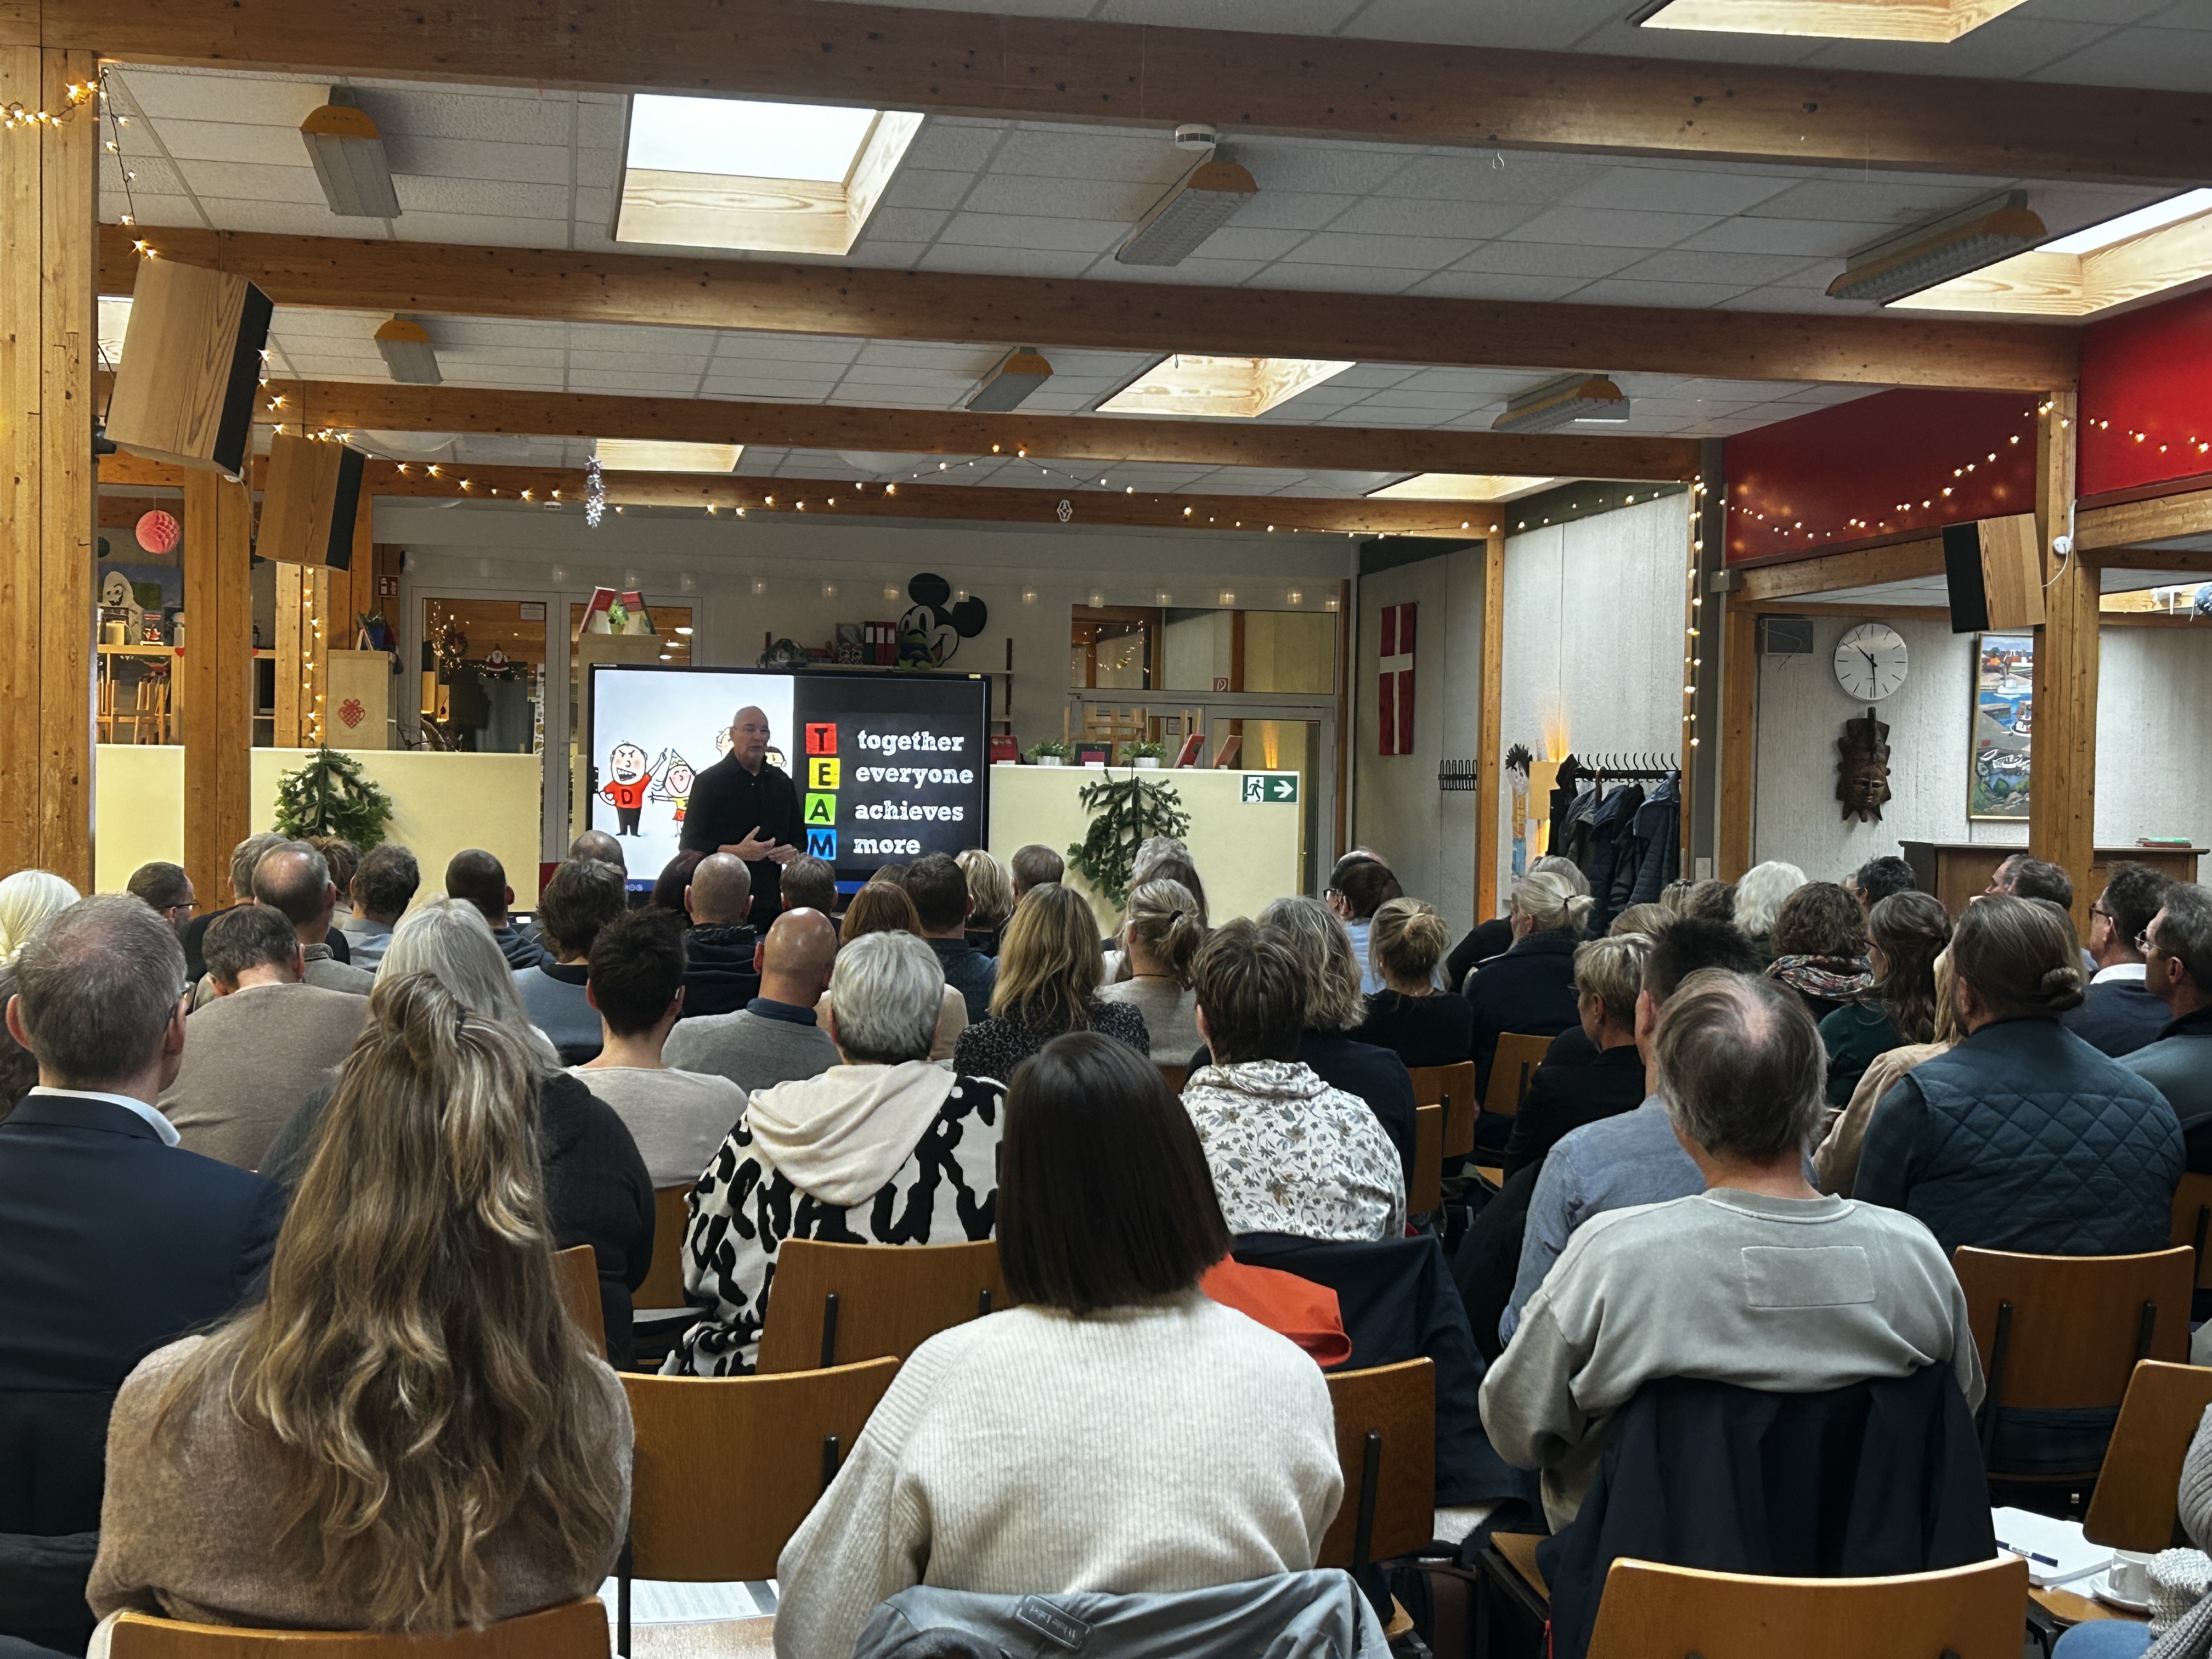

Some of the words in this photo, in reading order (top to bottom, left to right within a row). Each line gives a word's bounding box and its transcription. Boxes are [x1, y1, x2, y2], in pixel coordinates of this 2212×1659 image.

[815, 727, 828, 753] T
[857, 730, 965, 757] together
[818, 763, 832, 786] E
[855, 766, 974, 789] everyone
[620, 788, 633, 805] D
[809, 798, 831, 822] A
[854, 800, 964, 821] achieves
[808, 833, 834, 857] M
[853, 838, 921, 855] more
